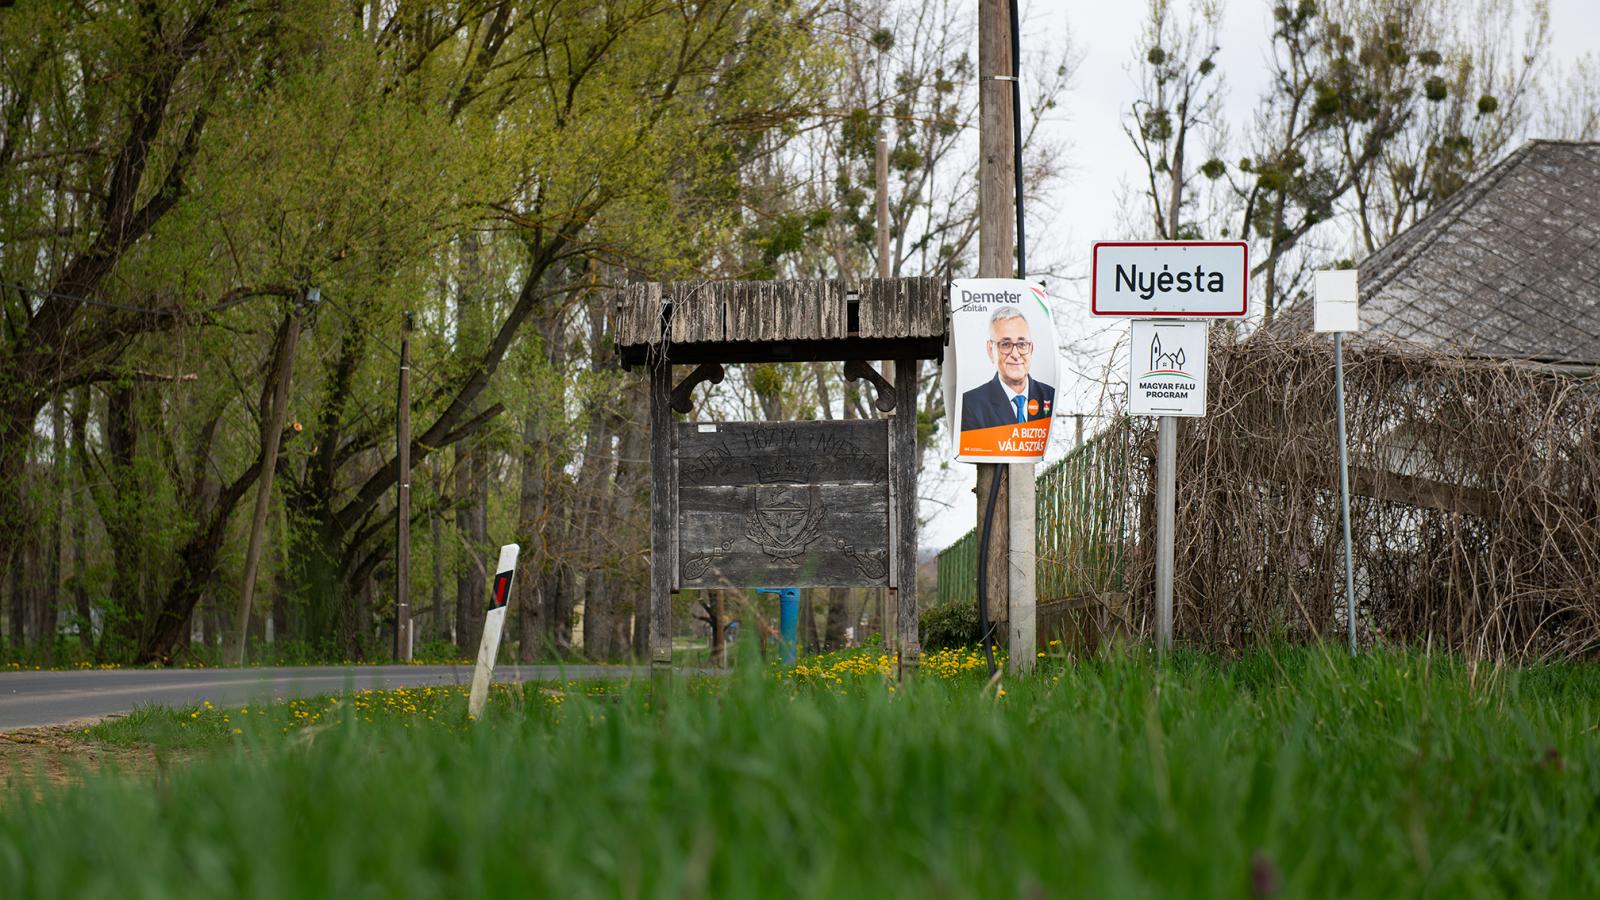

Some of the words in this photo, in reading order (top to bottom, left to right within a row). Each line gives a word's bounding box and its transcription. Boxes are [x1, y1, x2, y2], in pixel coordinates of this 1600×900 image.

[961, 290, 1022, 303] Demeter
[962, 304, 988, 312] Zoltán
[1139, 382, 1174, 390] MAGYAR
[1146, 391, 1188, 399] PROGRAM
[1012, 428, 1020, 438] A
[1021, 428, 1047, 438] BIZTOS
[998, 439, 1045, 452] VÁLASZTÁS
